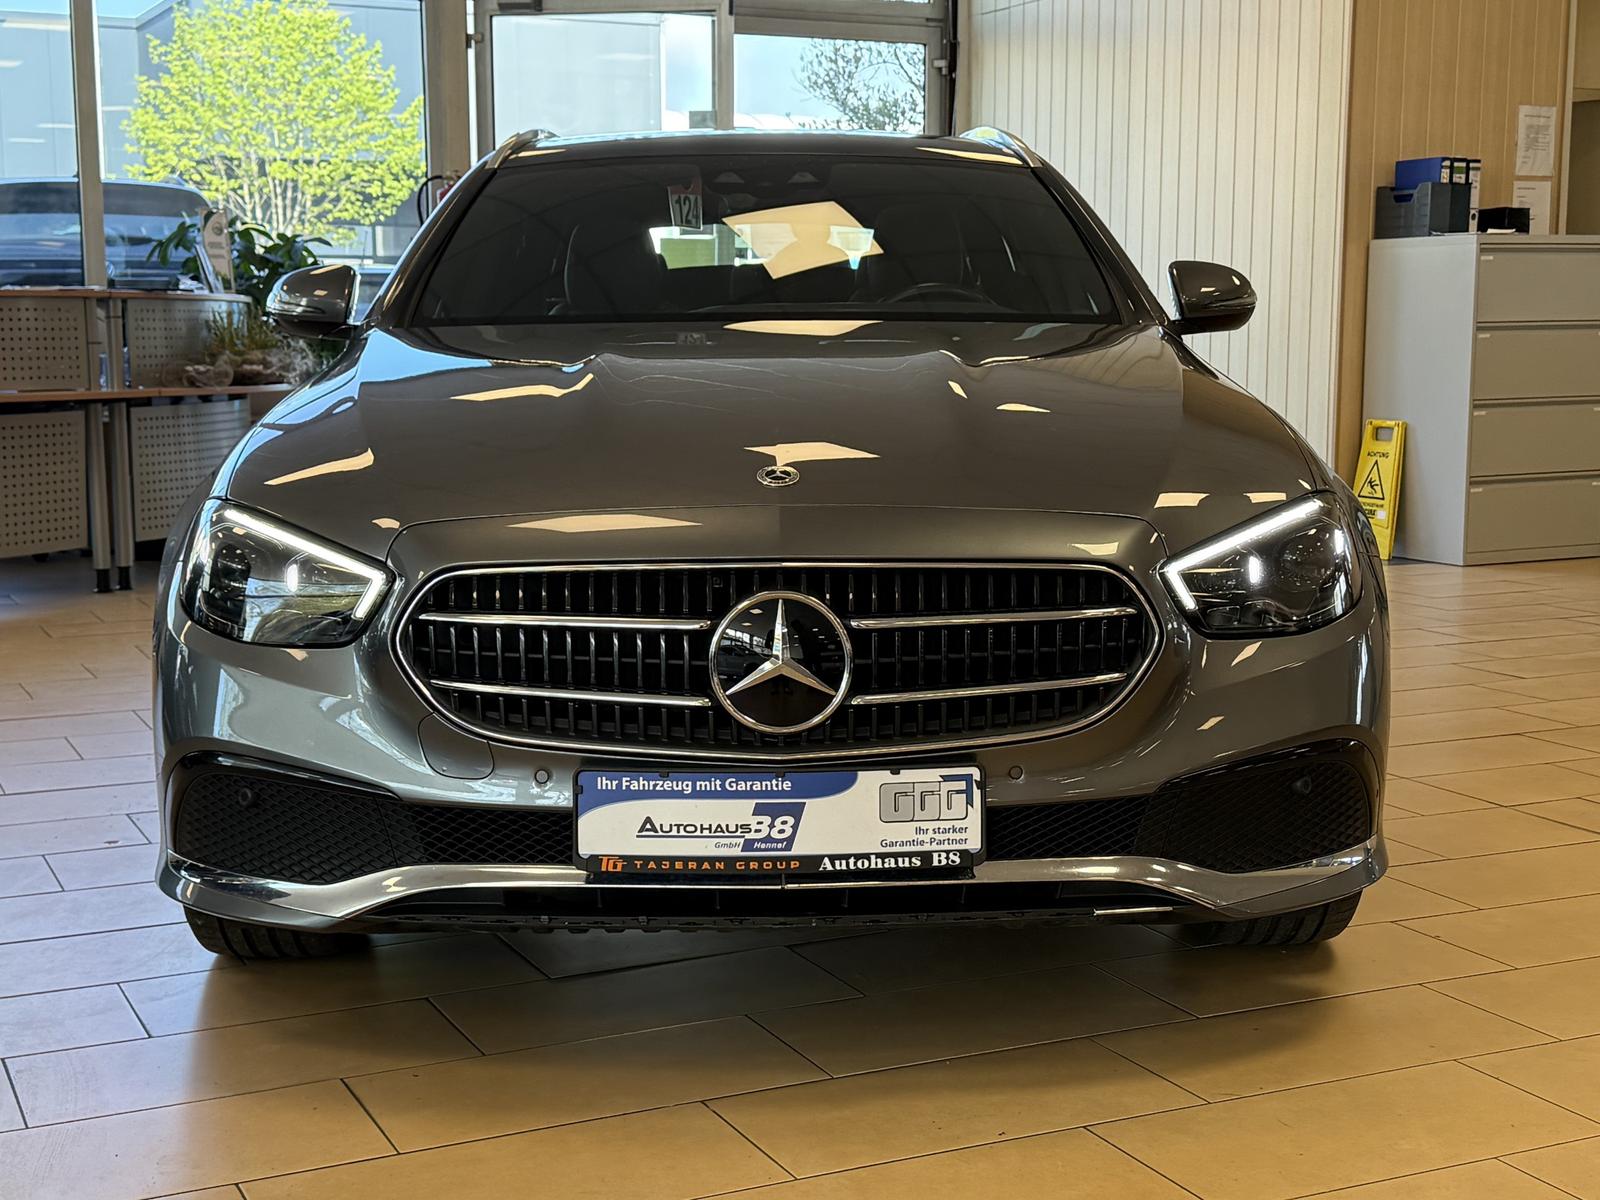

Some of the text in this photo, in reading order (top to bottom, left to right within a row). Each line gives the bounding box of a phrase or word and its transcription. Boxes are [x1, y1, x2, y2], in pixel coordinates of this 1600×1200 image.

[597, 776, 792, 794] Ihr Fahrzeug mit Garantie
[915, 825, 969, 835] Ihr starker
[714, 840, 787, 849] GmbH Hennef
[880, 837, 969, 848] Garantie-Partner
[634, 860, 726, 870] TAJERAN
[735, 860, 801, 870] GROUP
[818, 851, 961, 872] Autohaus B8
